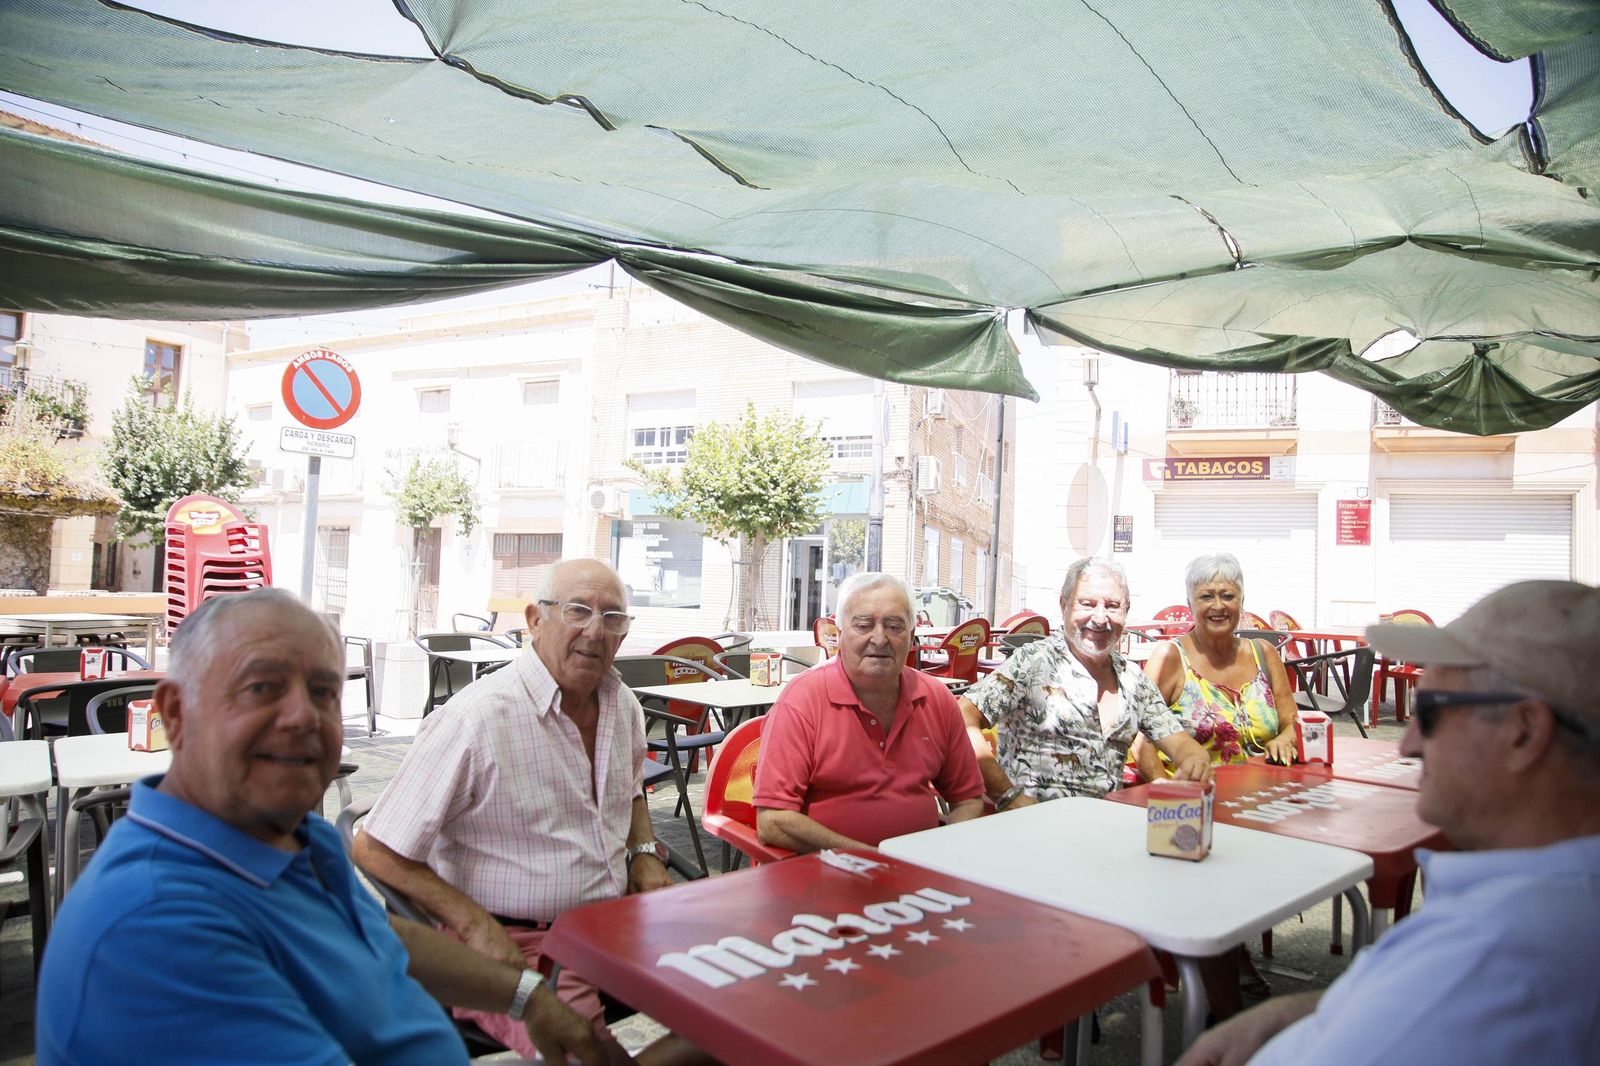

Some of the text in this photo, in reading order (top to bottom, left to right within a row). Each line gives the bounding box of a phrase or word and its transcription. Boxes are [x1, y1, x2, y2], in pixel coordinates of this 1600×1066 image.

[292, 350, 353, 373] AMBOS LADOS
[284, 429, 308, 439] CARGA
[317, 434, 353, 445] DESCARGA
[1174, 461, 1264, 475] TABACOS
[1148, 803, 1203, 822] ColaCao
[656, 887, 971, 989] Mahou
